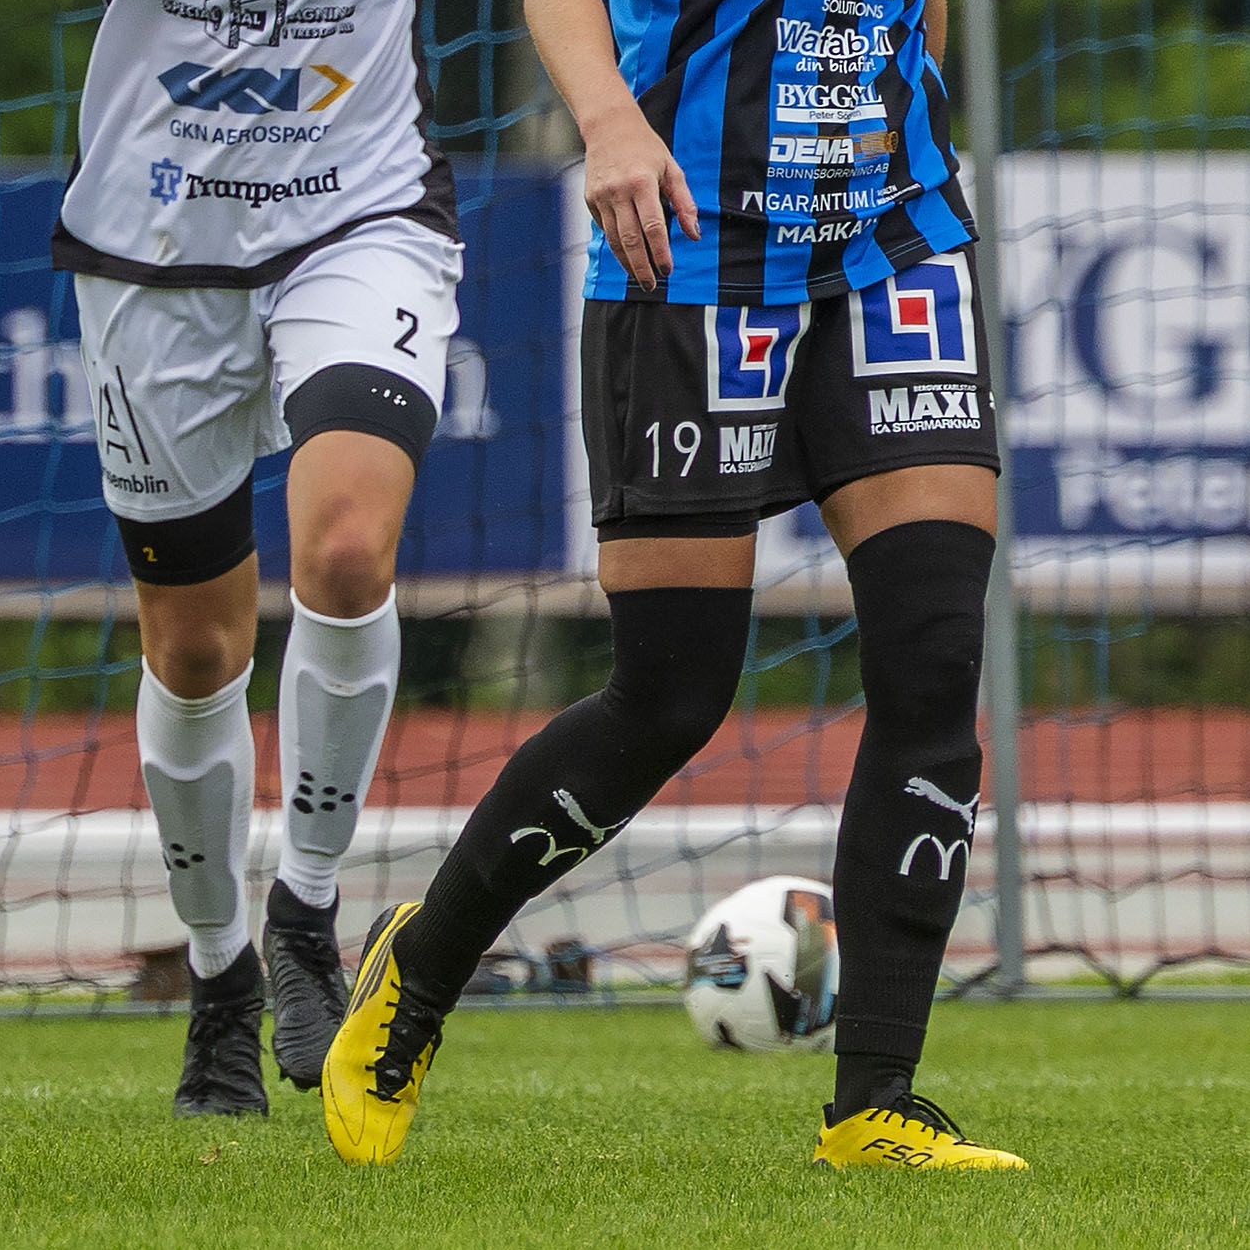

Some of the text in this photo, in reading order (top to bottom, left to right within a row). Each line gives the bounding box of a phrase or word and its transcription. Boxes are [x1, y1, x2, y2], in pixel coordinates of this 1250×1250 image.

[795, 57, 824, 72] din
[809, 110, 835, 120] Peter
[169, 119, 208, 142] GKN
[874, 162, 890, 174] AB
[766, 190, 869, 213] GARANTUM
[393, 306, 419, 359] 2
[868, 387, 980, 425] MAXI
[870, 418, 981, 435] ICA STORMARKNAD
[645, 420, 701, 478] 19
[142, 546, 158, 562] 2
[861, 1137, 933, 1168] F50
